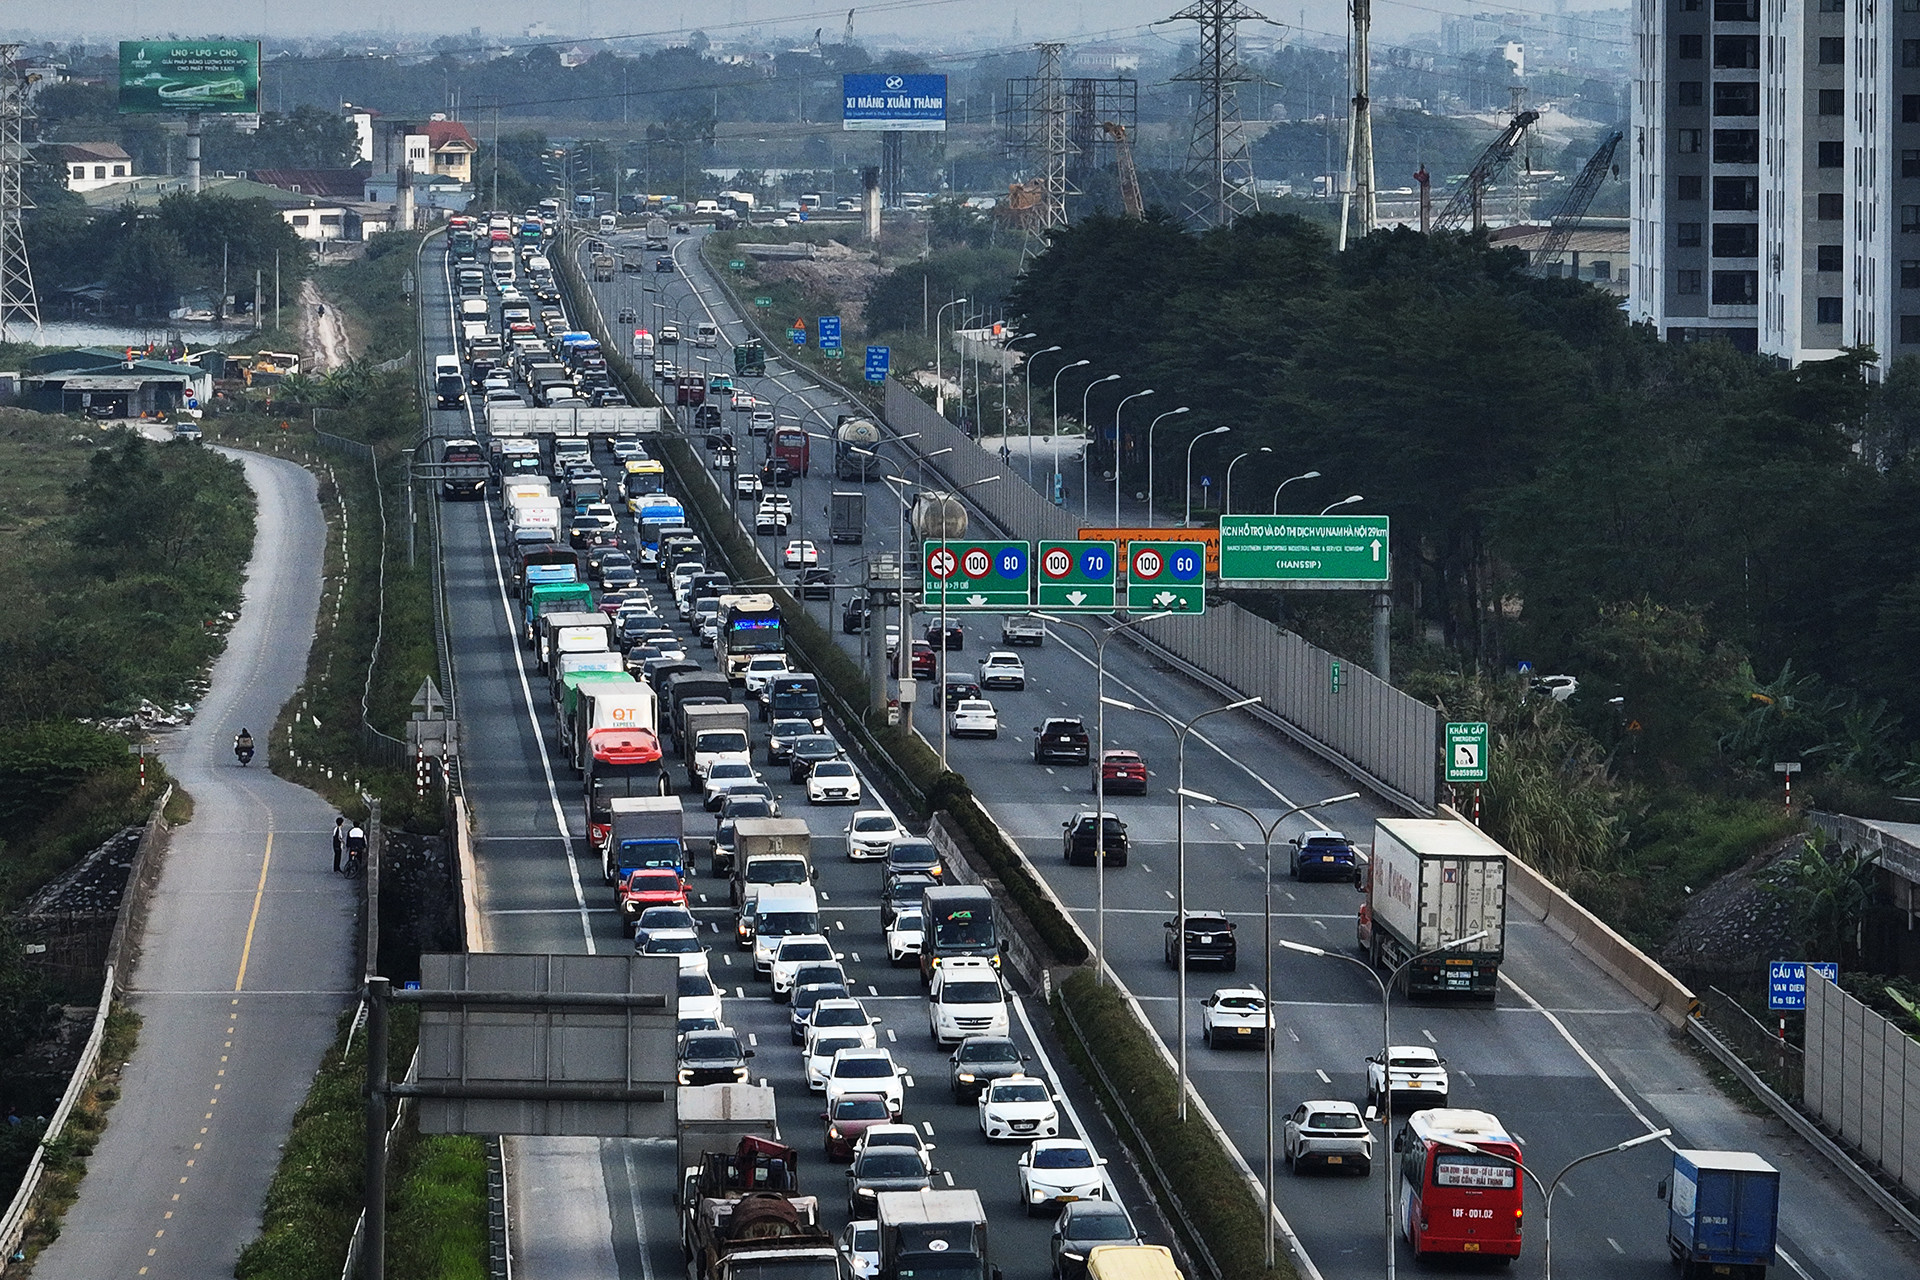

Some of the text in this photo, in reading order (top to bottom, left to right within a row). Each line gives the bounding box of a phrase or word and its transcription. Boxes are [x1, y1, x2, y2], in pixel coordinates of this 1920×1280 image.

[171, 49, 188, 57] LNG
[195, 49, 212, 57] LPG
[219, 49, 238, 57] CNG
[846, 94, 943, 109] XI MĂNG XUÂN THÀNH
[1222, 526, 1238, 537] KCN
[1250, 526, 1264, 538] TRỢ
[1264, 524, 1274, 537] VÀ
[1274, 525, 1286, 536] ĐÔ
[1297, 526, 1315, 538] DỊCH
[1326, 526, 1343, 537] NAM
[1343, 524, 1354, 537] HÀ
[1354, 525, 1367, 538] NỘI
[968, 556, 986, 570] 100
[1003, 556, 1018, 570] 80
[1049, 556, 1067, 570] 100
[1088, 556, 1103, 570] 70
[1140, 557, 1157, 570] 100
[1177, 557, 1193, 571] 60
[613, 708, 636, 721] QT
[1794, 965, 1805, 979] VĂ
[1773, 984, 1805, 992] VAN DIEN
[1452, 1208, 1464, 1217] 18F
